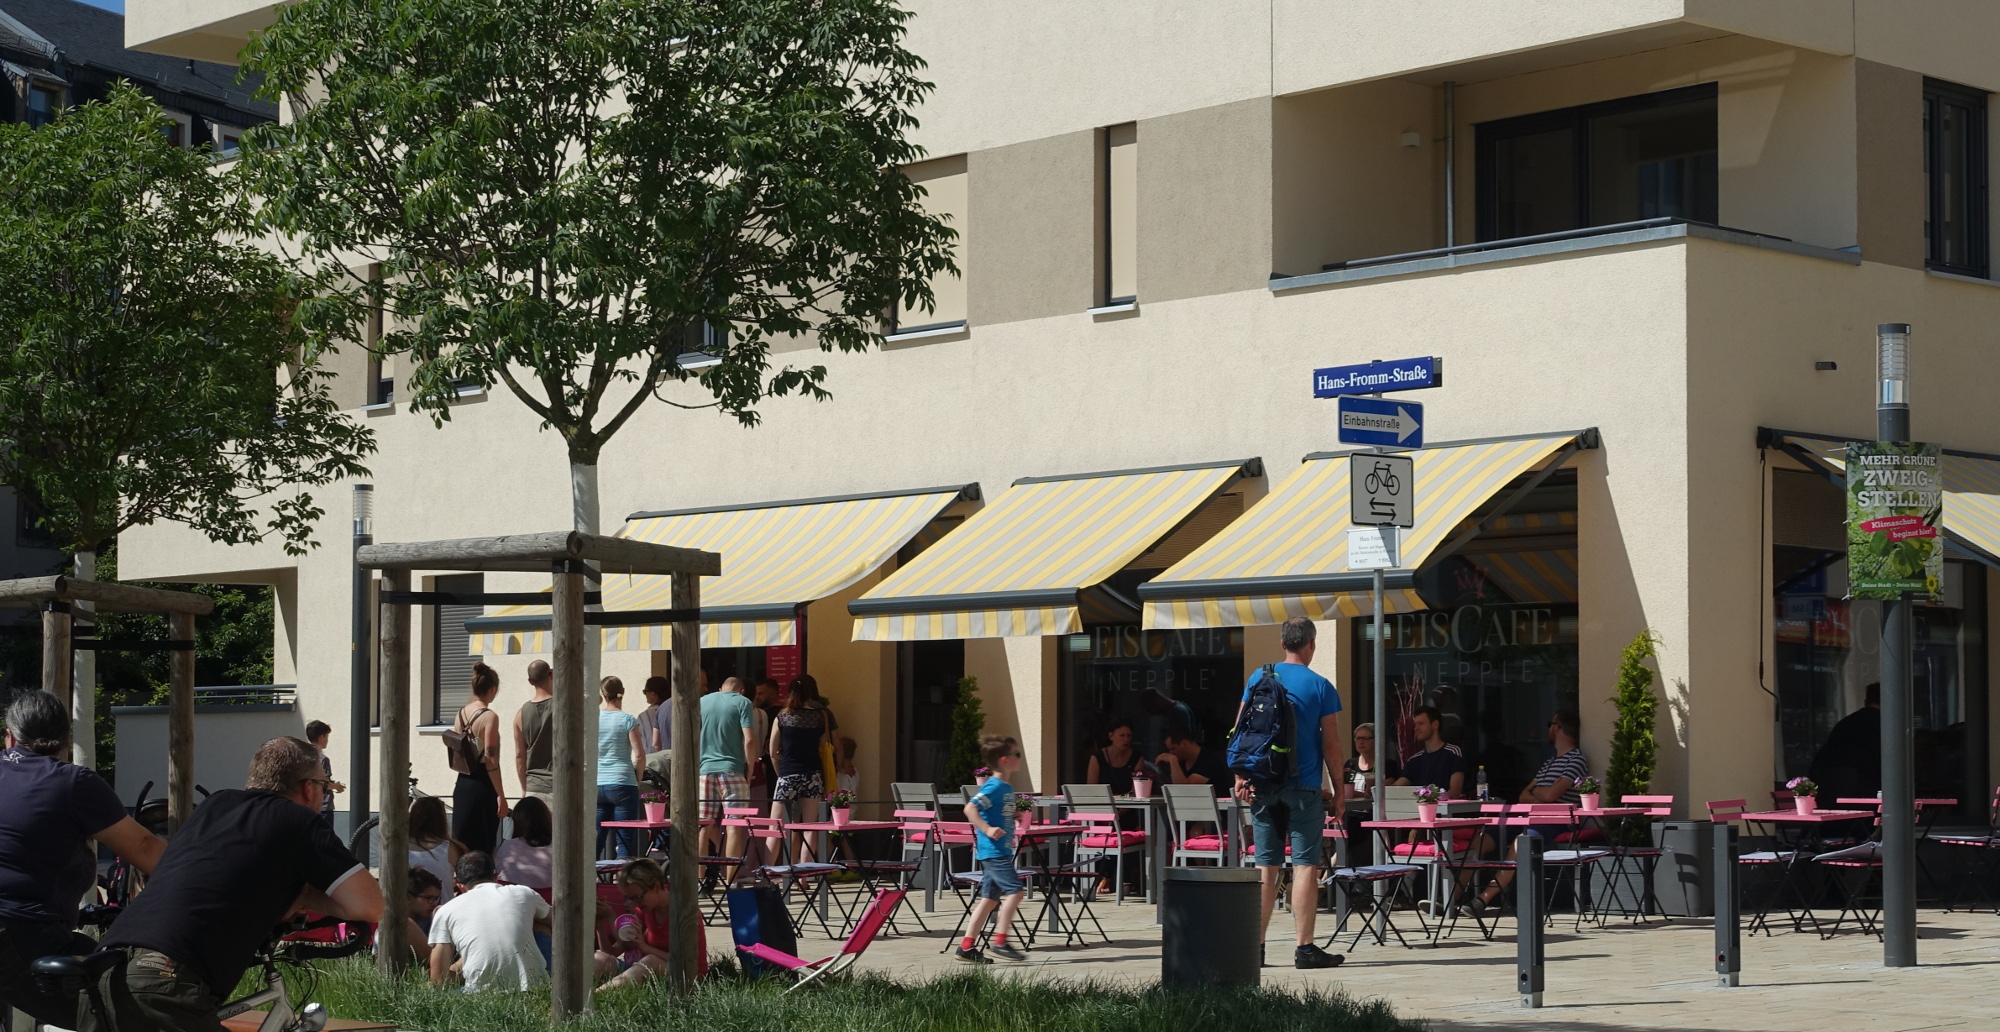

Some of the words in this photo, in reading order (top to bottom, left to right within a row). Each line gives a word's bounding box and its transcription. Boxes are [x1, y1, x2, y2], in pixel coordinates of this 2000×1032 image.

[1318, 365, 1427, 391] Hans-Fromm-Straße
[1344, 414, 1400, 430] Einbahnstraße
[1860, 455, 1900, 466] MEHR
[1902, 453, 1936, 466] GRÜNE
[1863, 470, 1933, 486] ZWEIG-
[1857, 490, 1937, 508] STELLEN
[1871, 518, 1917, 529] Klimaschutz
[1893, 528, 1919, 538] beginnt
[1919, 527, 1933, 536] hier!
[1413, 659, 1533, 685] NEPPLE
